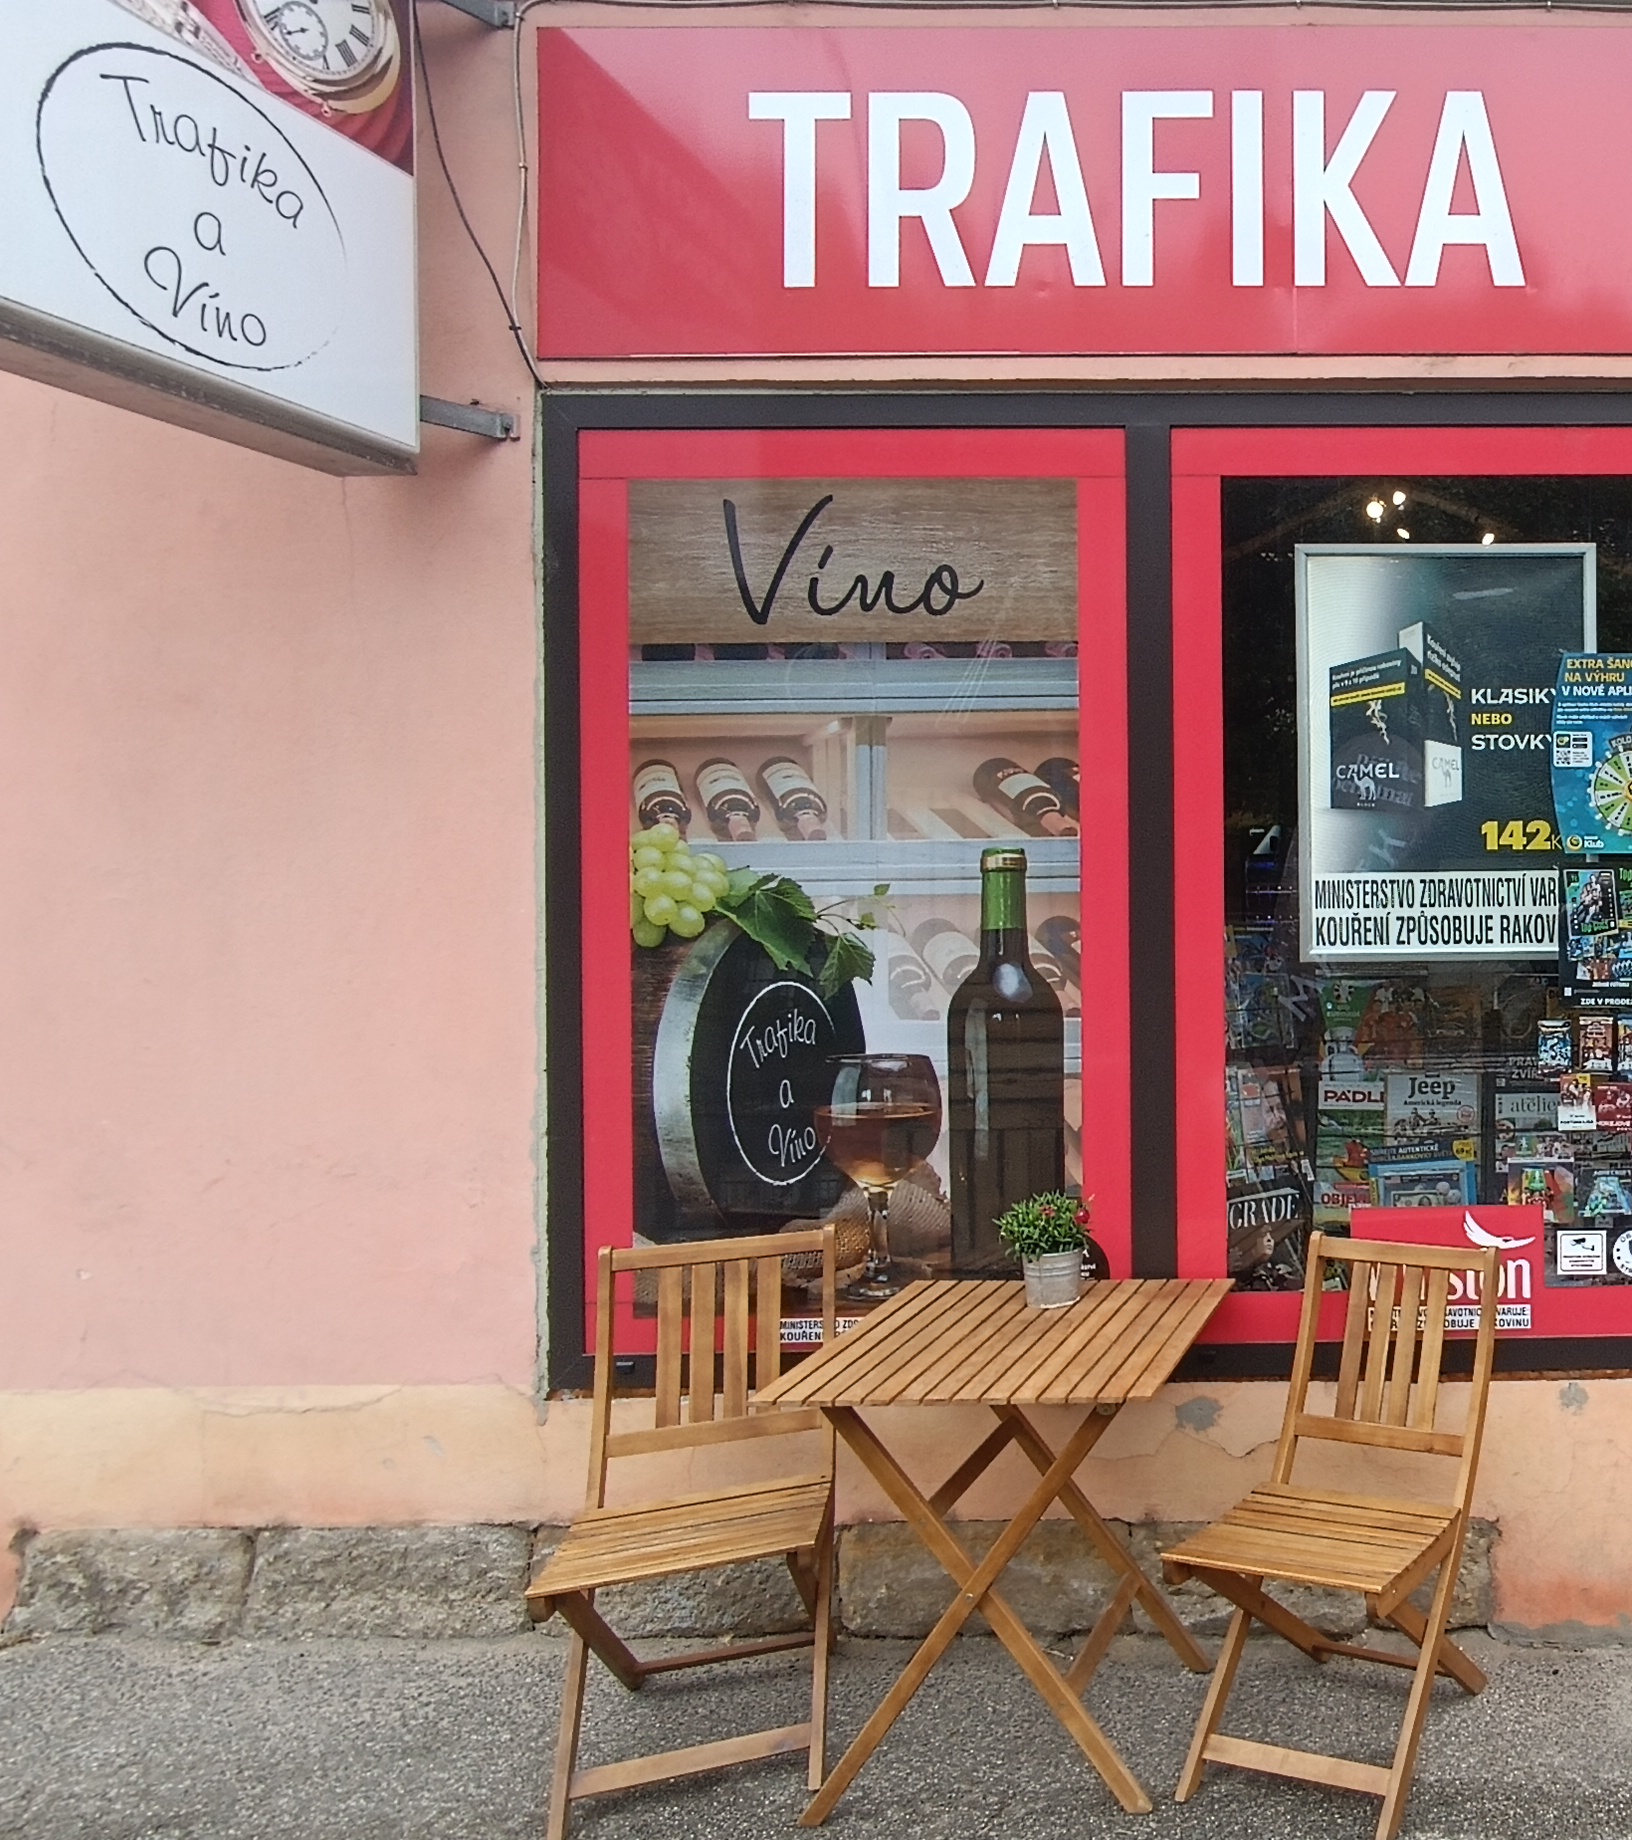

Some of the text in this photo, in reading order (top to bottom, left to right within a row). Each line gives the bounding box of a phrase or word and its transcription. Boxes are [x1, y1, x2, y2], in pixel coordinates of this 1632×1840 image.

[100, 73, 304, 230] Trafika
[748, 90, 1526, 288] TRAFIKA
[194, 211, 226, 256] a
[144, 246, 267, 347] Víno
[723, 494, 984, 625] Víno
[1565, 670, 1625, 682] NA VÝHRU
[1566, 658, 1604, 669] EXTRA
[1471, 688, 1556, 704] KLASIK
[1562, 686, 1571, 696] V
[1572, 684, 1605, 696] NOVÉ
[1471, 713, 1513, 725] NEBO
[1471, 734, 1552, 750] STOVK
[1336, 763, 1400, 781] CAMEL
[1431, 756, 1460, 771] CAMEL
[1315, 873, 1557, 910] MINISTERSTVO ZDRAVOTNICTVÍ VAR
[1316, 913, 1390, 946] KOUŘENÍ
[1396, 910, 1494, 945] ZPŮSOBUJE
[1500, 913, 1557, 944] RAKOV
[739, 1008, 816, 1069] Trafika
[779, 1079, 794, 1109] a
[1408, 1077, 1456, 1100] Jeep
[768, 1123, 816, 1168] Víno
